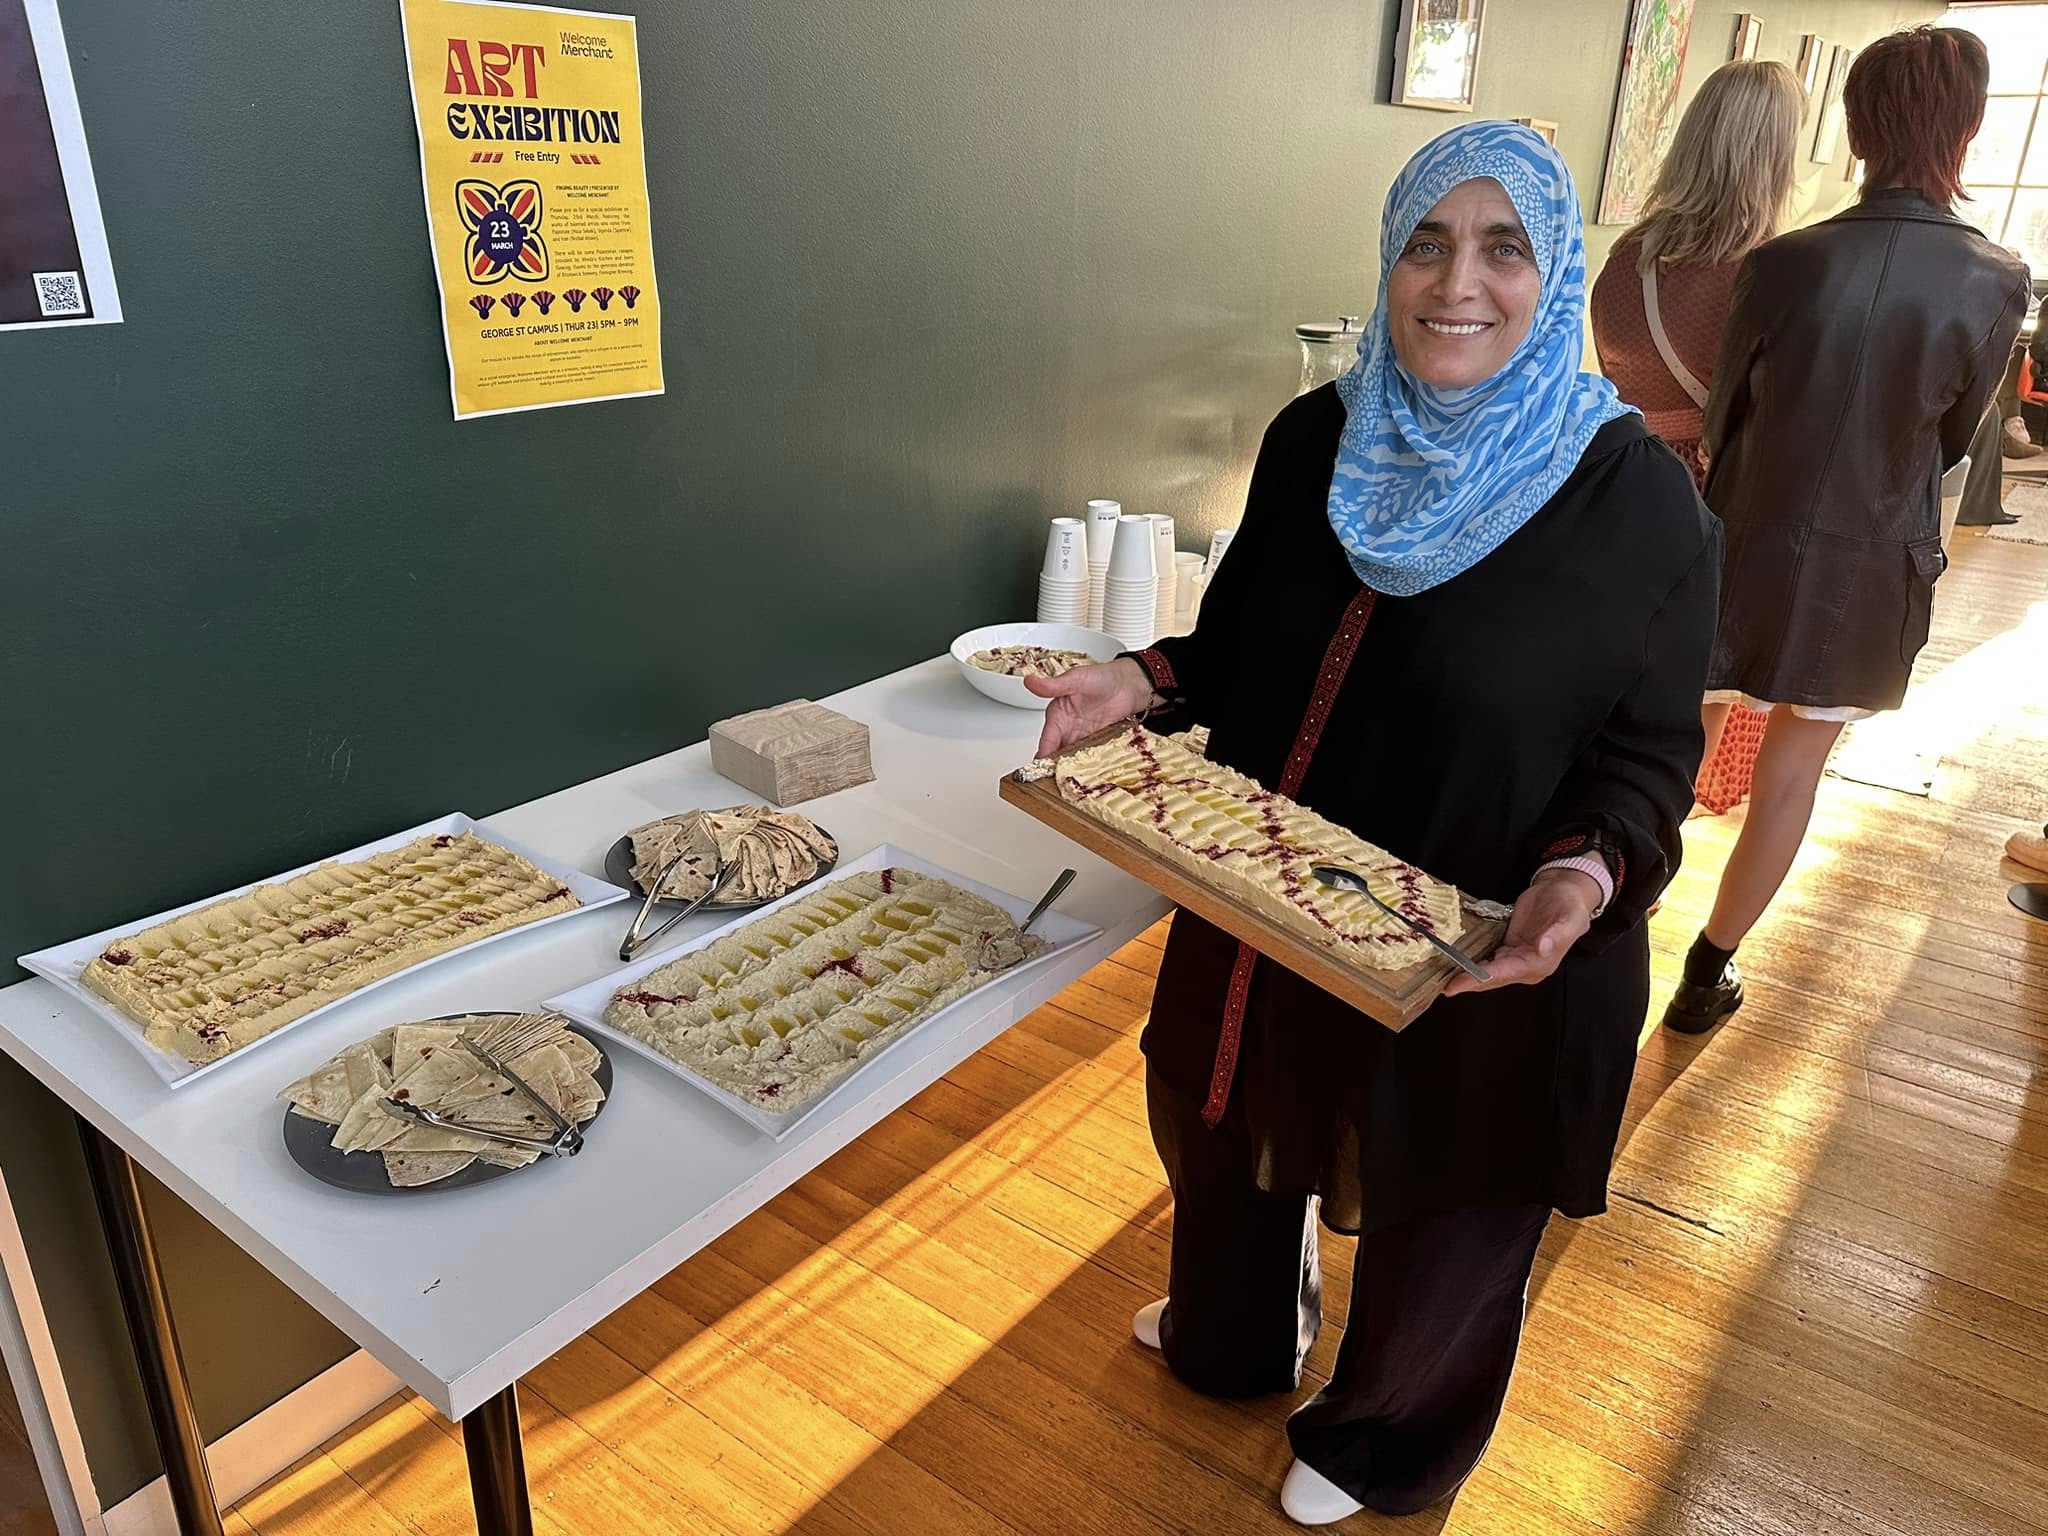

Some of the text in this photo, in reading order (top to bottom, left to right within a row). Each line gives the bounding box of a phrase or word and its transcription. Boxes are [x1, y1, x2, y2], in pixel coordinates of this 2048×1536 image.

[560, 32, 607, 46] Welcome
[561, 44, 614, 59] Merchant
[444, 38, 546, 99] ART
[446, 102, 621, 144] EXHIBITION
[515, 151, 560, 164] Free Entry
[490, 221, 510, 238] 23
[491, 242, 513, 250] MARCH
[481, 327, 514, 338] GEORGE
[516, 326, 525, 336] ST
[527, 324, 558, 334] CAMPUS
[564, 322, 585, 331] THUR
[600, 320, 616, 328] 5PM
[624, 318, 638, 326] 9PM
